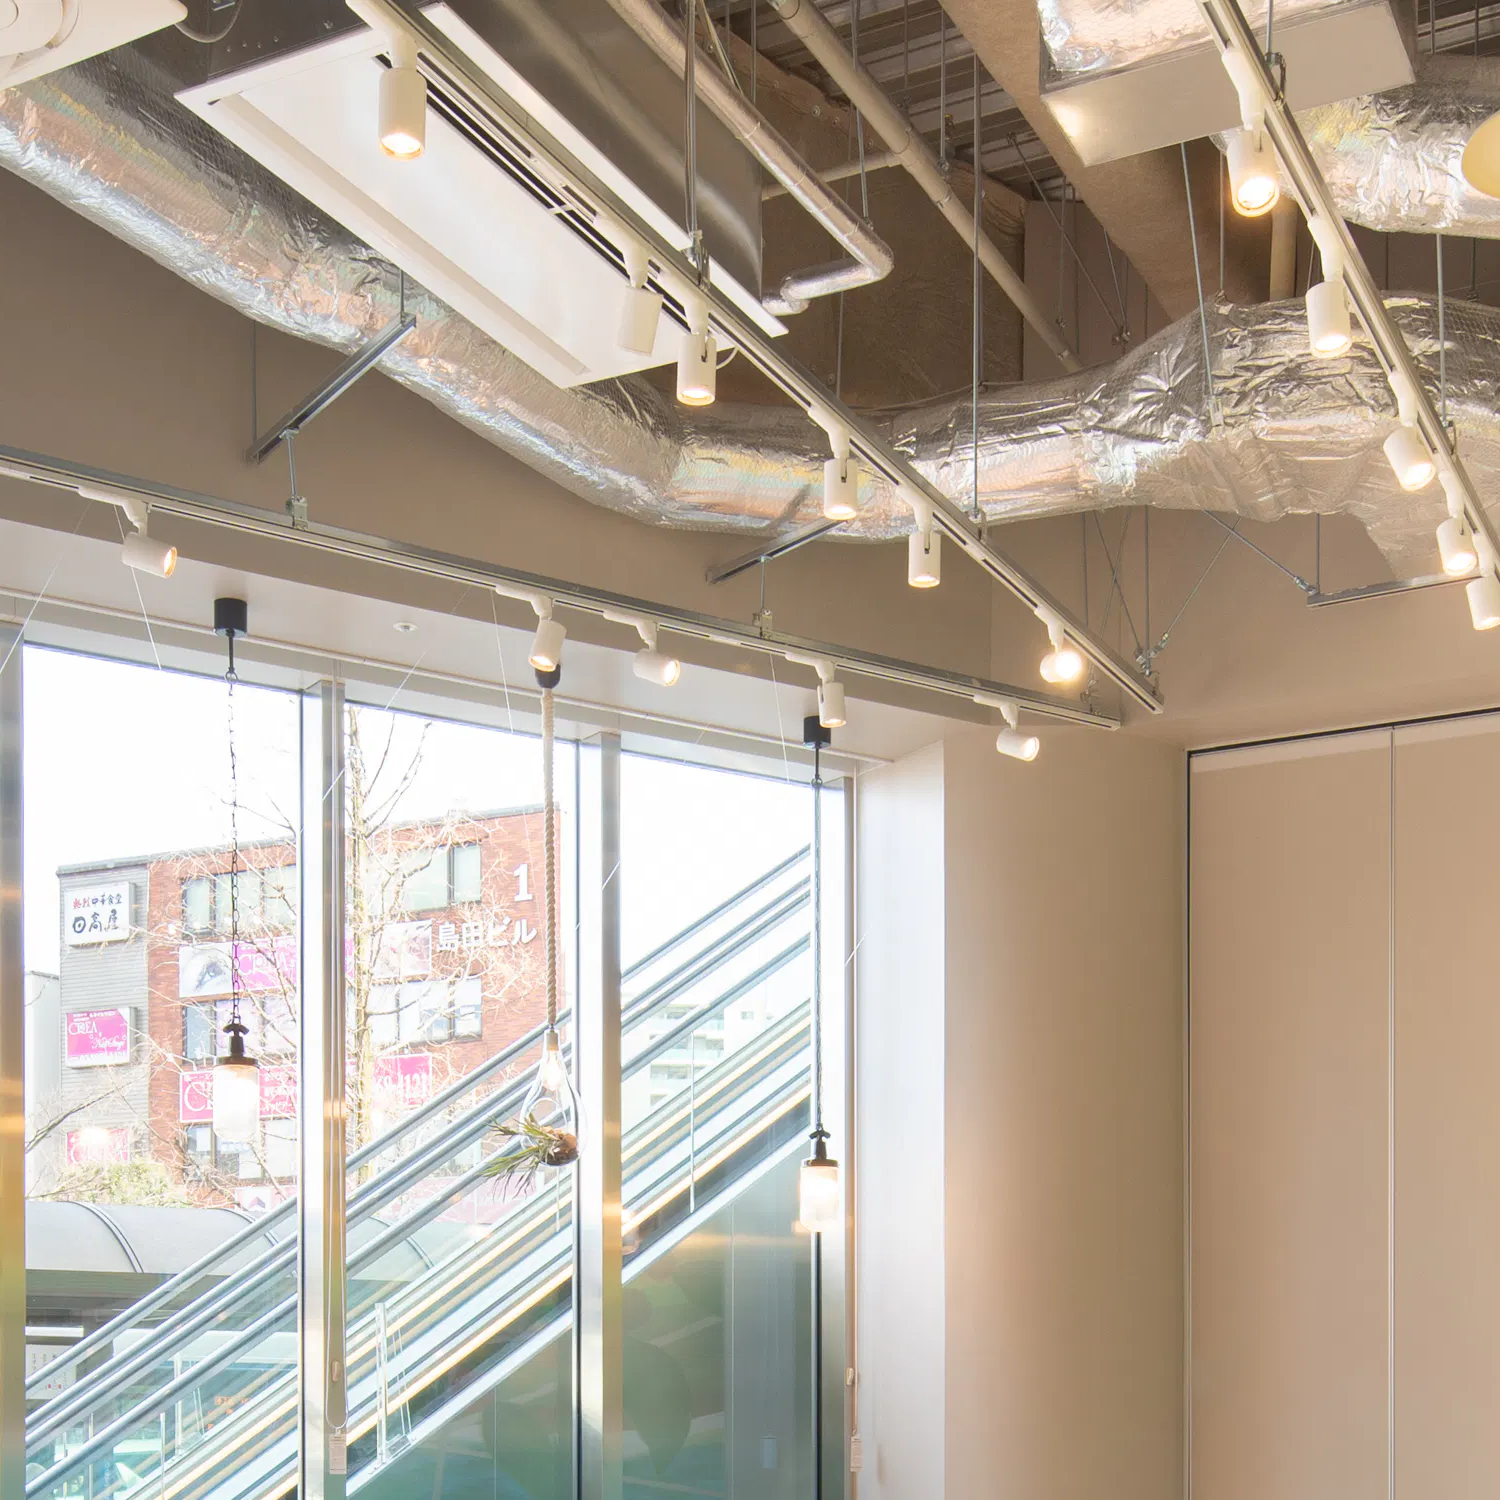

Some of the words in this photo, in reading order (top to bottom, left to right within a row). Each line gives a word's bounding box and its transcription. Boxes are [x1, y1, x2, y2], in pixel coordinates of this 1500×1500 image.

[513, 863, 533, 902] 1
[72, 908, 119, 934] 日高屋
[436, 915, 538, 953] 島田ビル
